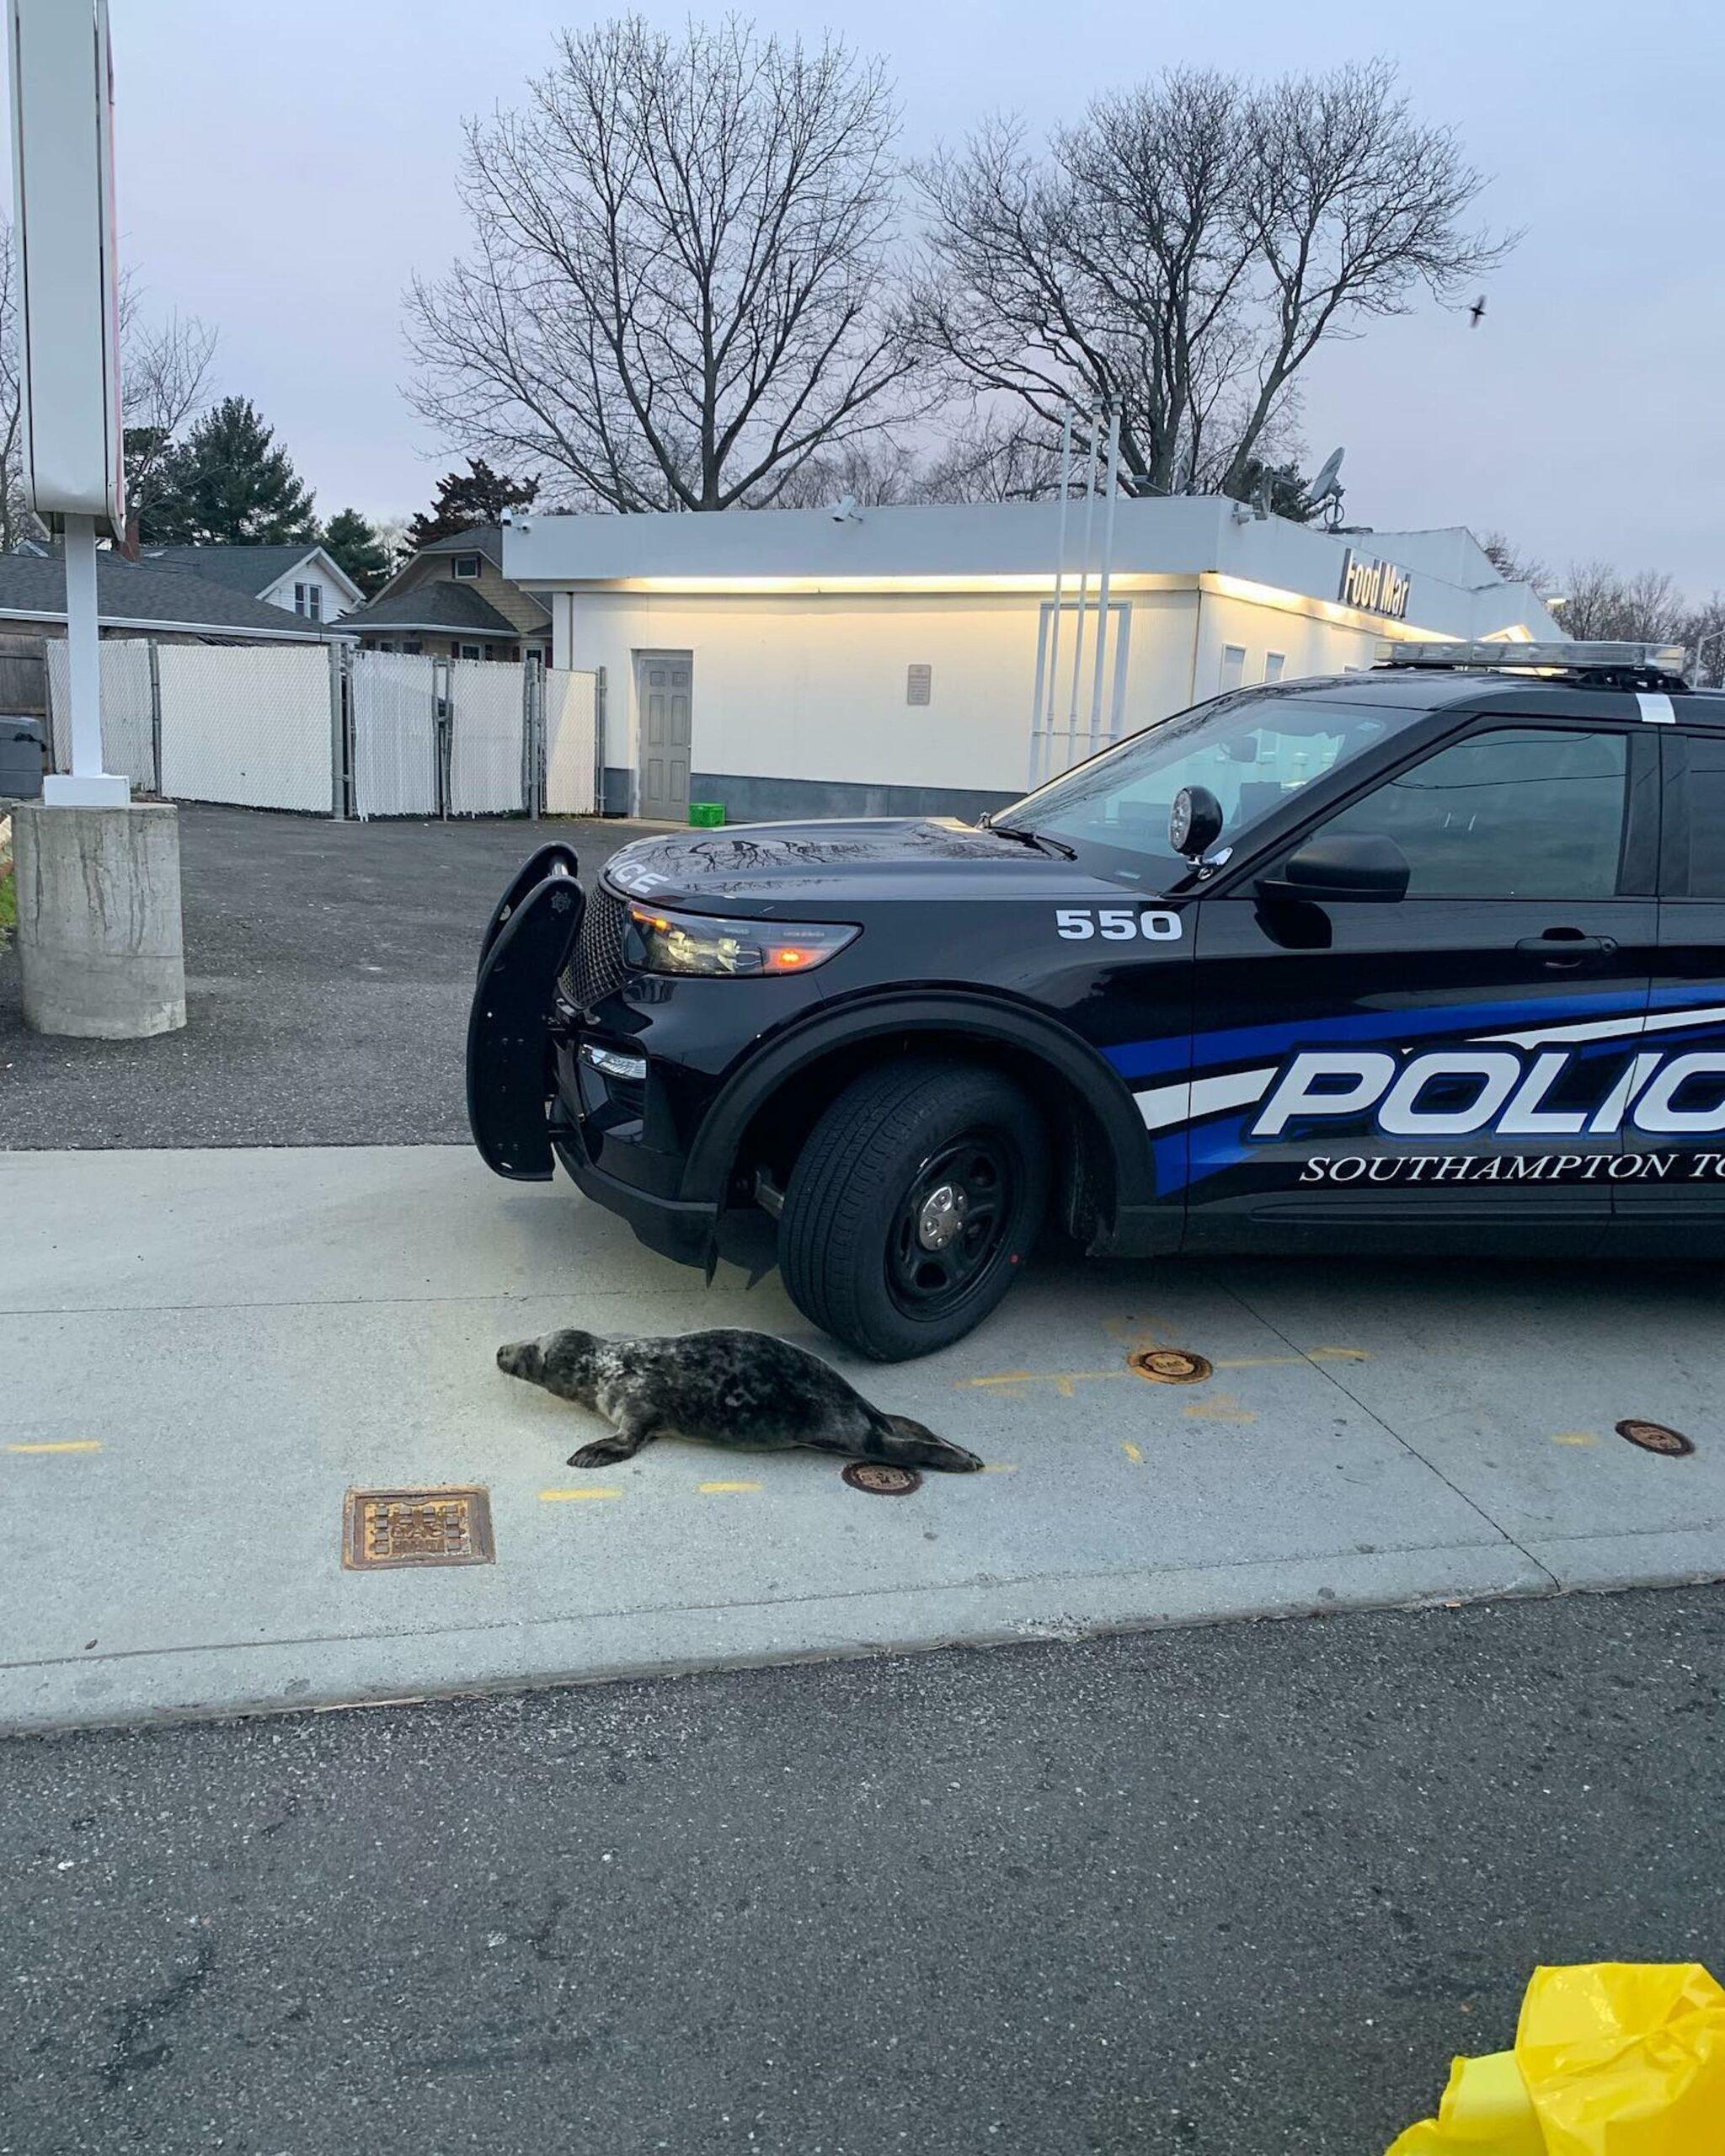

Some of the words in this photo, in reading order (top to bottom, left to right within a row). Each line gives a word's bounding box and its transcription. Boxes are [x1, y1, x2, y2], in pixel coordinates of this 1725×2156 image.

[1339, 548, 1382, 609] Food
[1379, 560, 1410, 618] Mar
[1055, 910, 1183, 941] 550
[1299, 1154, 1680, 1182] SOUTHAMPTON
[1689, 1154, 1725, 1177] T
